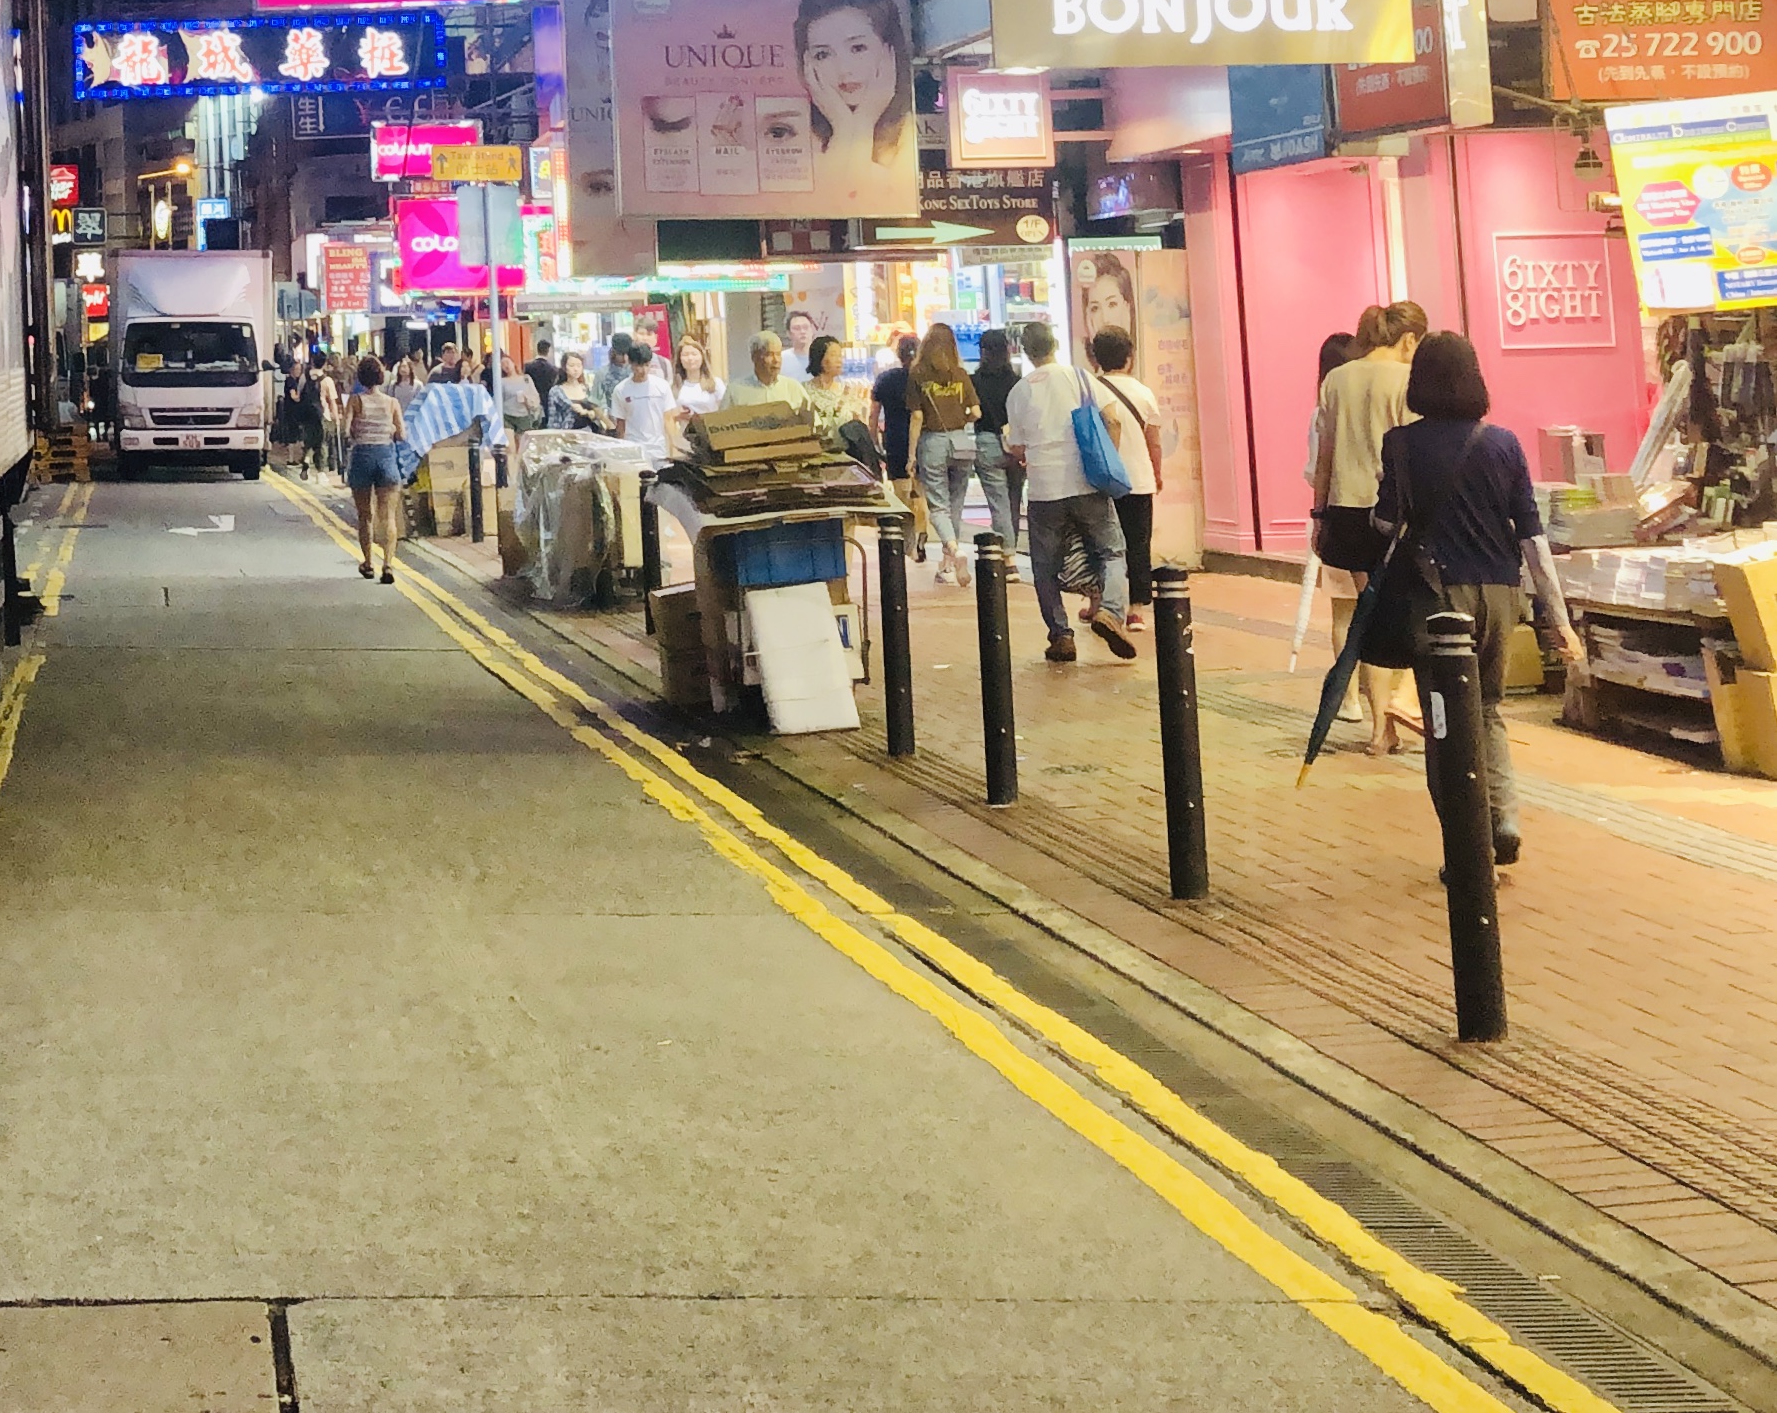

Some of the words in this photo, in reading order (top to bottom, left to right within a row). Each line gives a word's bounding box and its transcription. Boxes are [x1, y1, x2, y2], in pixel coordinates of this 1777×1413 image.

[664, 43, 785, 69] UNIQUE
[1601, 33, 1639, 58] 25
[1643, 31, 1699, 58] 722
[1706, 30, 1763, 56] 900
[450, 151, 472, 162] Taxi
[472, 150, 504, 162] Stand
[74, 211, 104, 241] 翠
